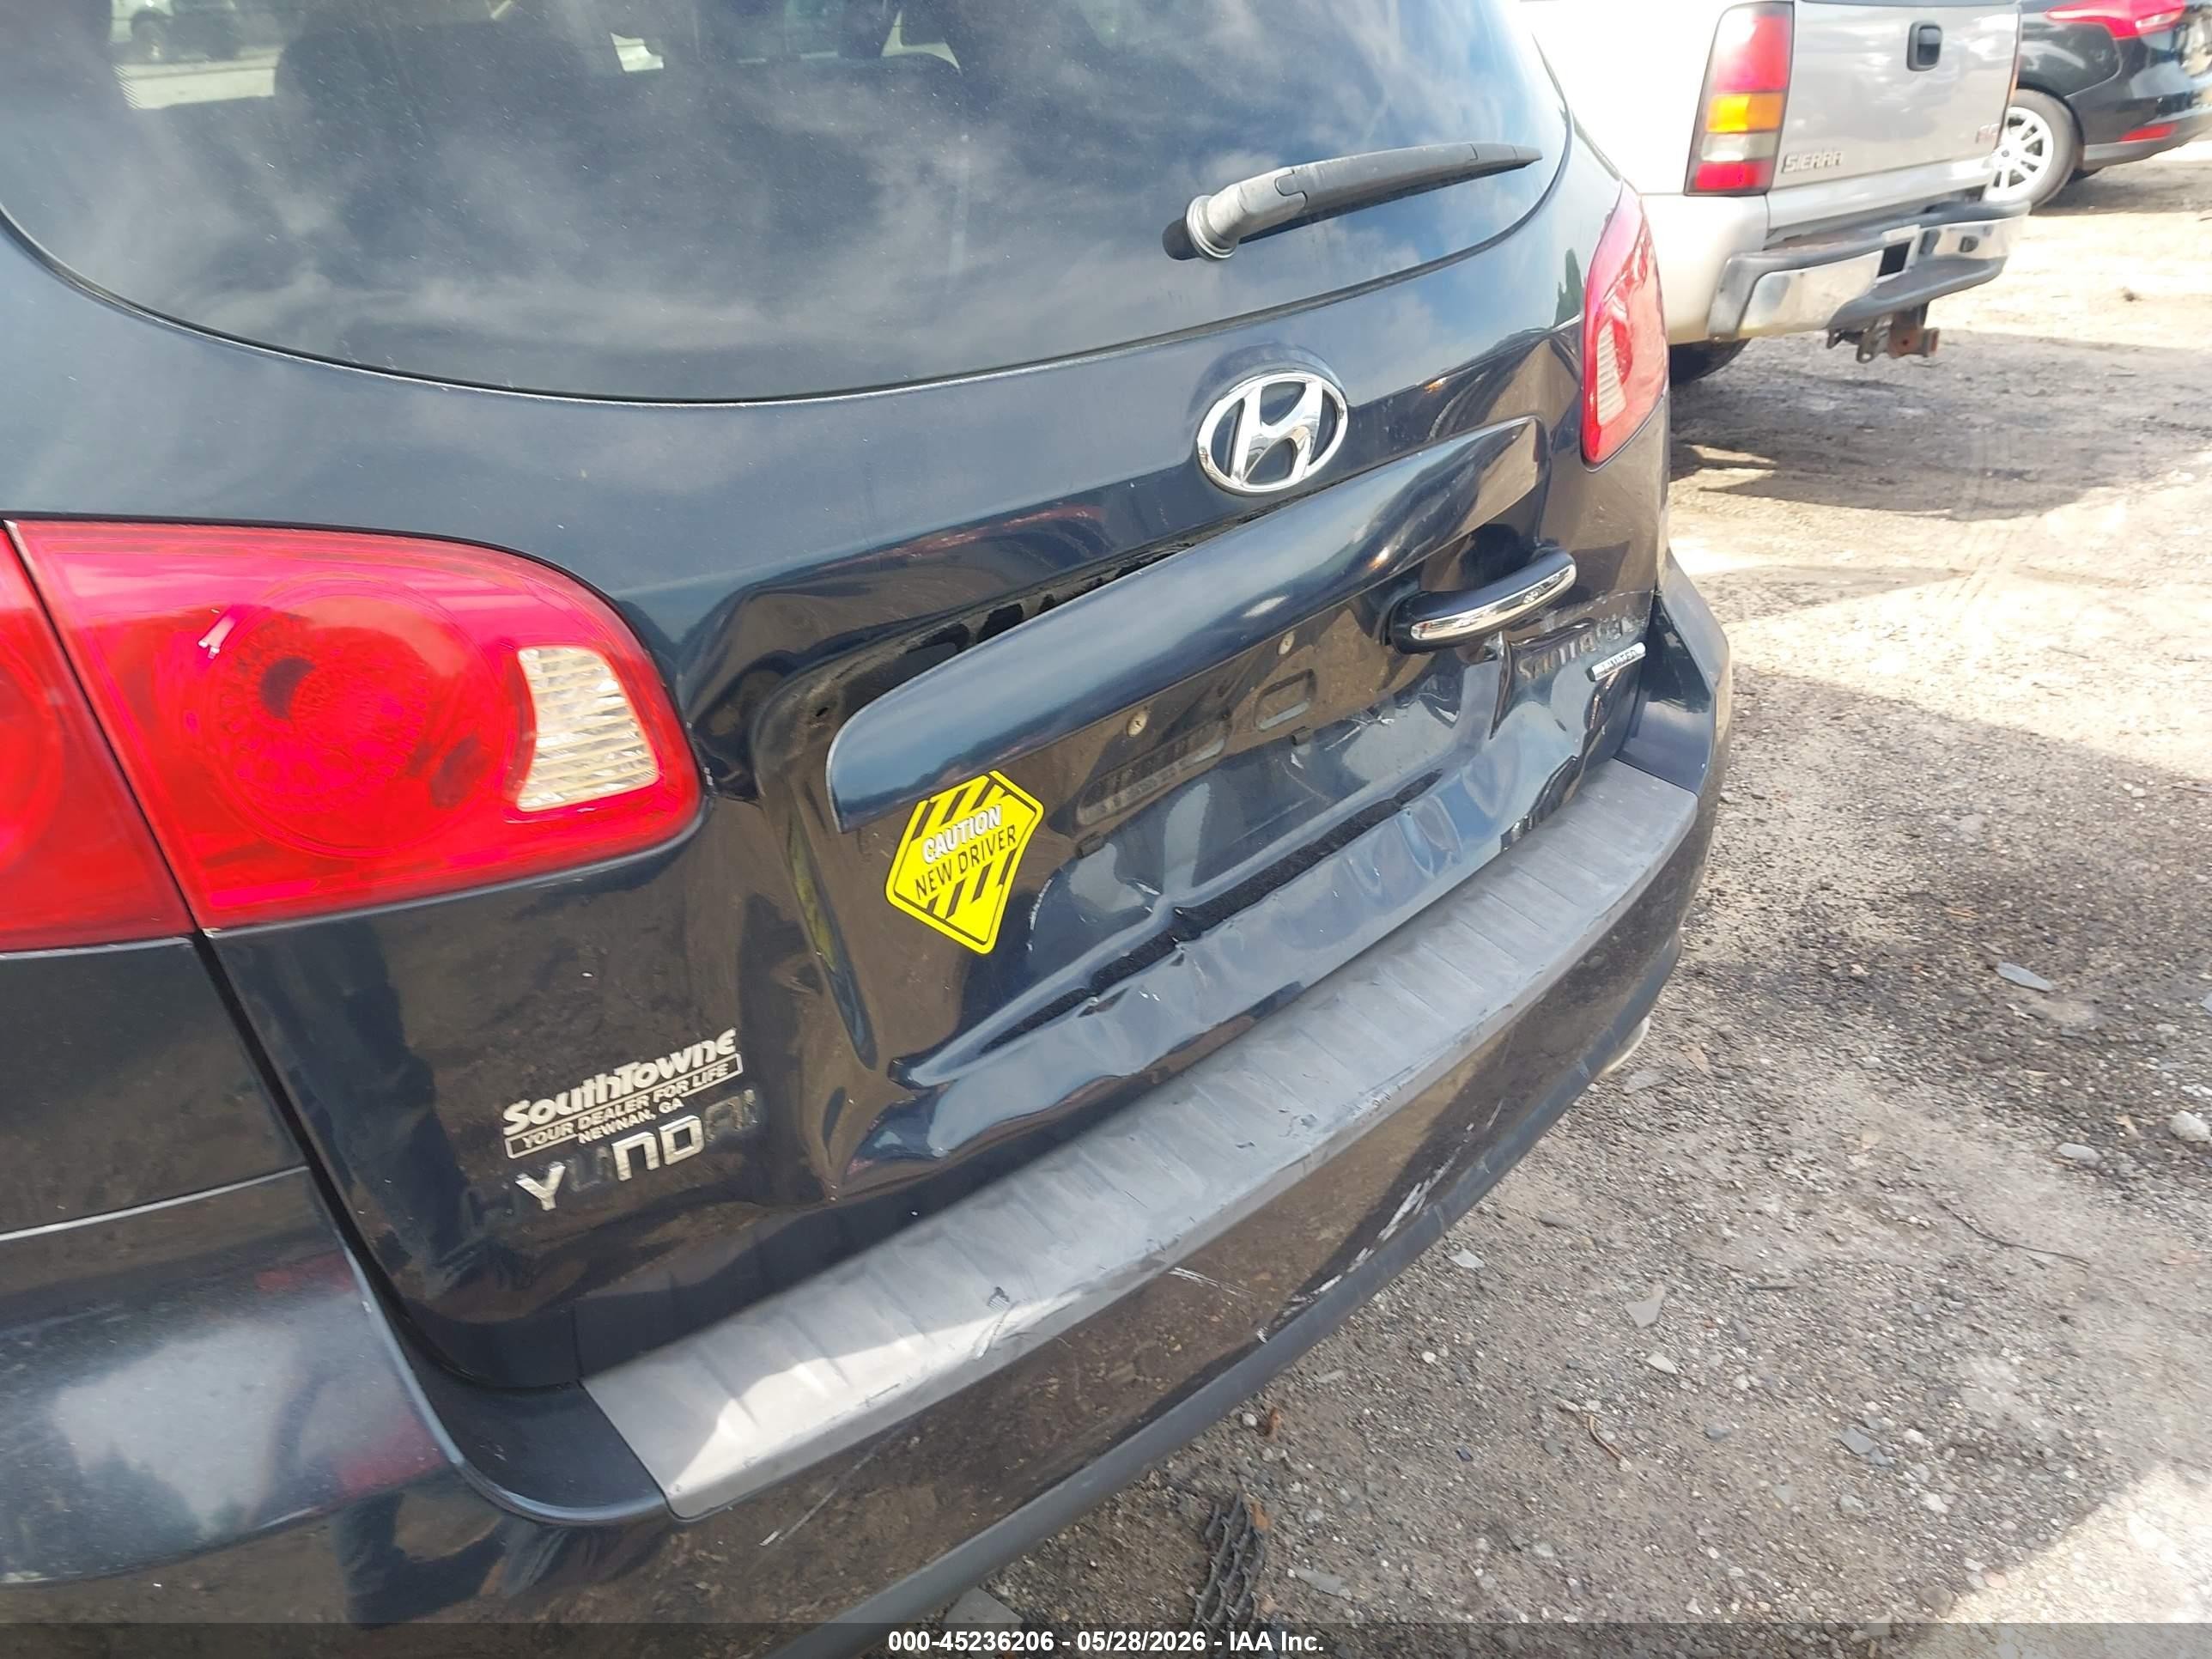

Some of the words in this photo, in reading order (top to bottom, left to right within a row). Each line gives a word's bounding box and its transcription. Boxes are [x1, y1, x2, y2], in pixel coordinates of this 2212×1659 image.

[1782, 149, 1844, 173] SIERRA
[915, 859, 952, 900] NEW
[959, 824, 1017, 874] DRIVER
[922, 805, 1002, 863] CAUTION
[522, 1121, 574, 1149] YOUR
[578, 1095, 650, 1130] DEALER
[653, 1079, 690, 1104] FOR
[693, 1062, 730, 1085] LIFE
[658, 1097, 684, 1114] GA
